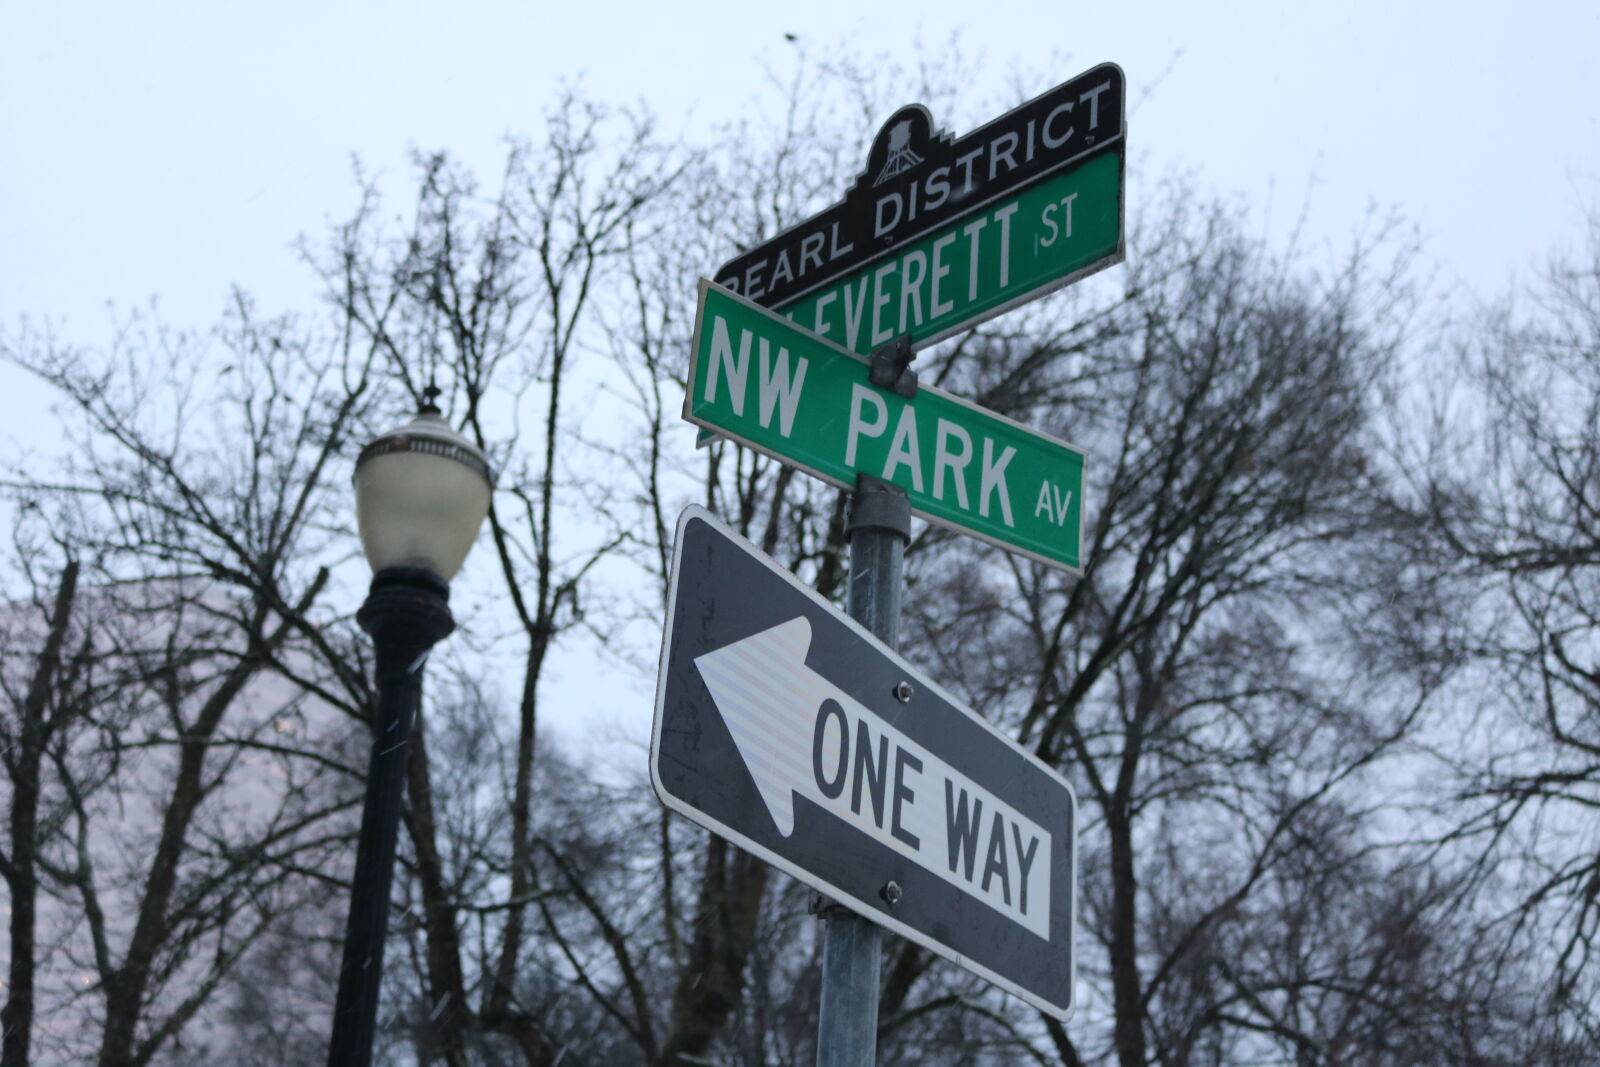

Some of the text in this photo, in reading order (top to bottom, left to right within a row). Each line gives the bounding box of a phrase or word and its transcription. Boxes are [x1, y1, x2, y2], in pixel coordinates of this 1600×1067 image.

[874, 80, 1111, 239] DISTRICT
[1040, 192, 1079, 247] ST
[704, 315, 1072, 528] NW PARK AV
[813, 698, 1040, 916] ONE WAY
